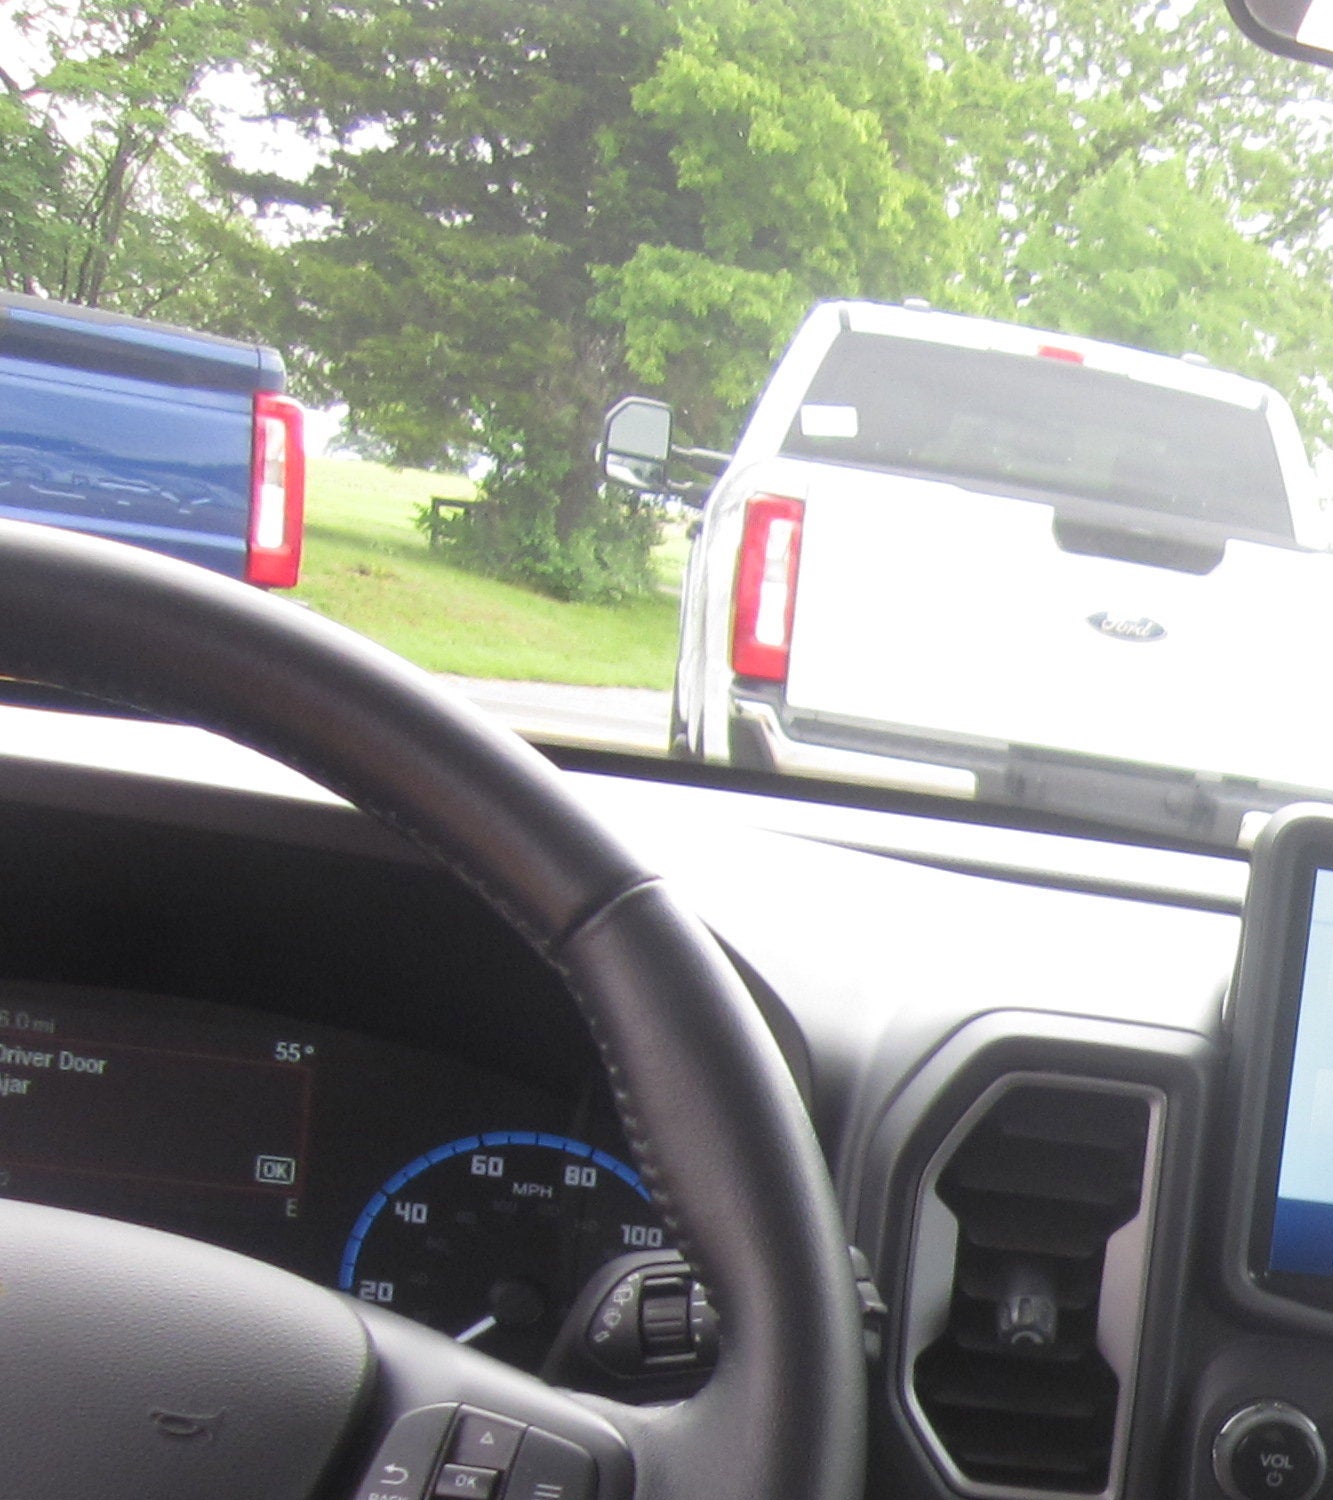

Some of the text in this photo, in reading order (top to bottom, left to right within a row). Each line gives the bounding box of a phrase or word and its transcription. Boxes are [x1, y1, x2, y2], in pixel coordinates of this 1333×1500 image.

[59, 1050, 107, 1075] Door
[263, 1160, 289, 1180] OK
[471, 1153, 504, 1178] 60
[564, 1164, 597, 1188] 80
[511, 1181, 553, 1199] MPH
[394, 1201, 428, 1225] 40
[620, 1223, 663, 1248] 100
[359, 1280, 394, 1302] 20
[1260, 1453, 1294, 1470] VOL
[455, 1473, 478, 1489] OK
